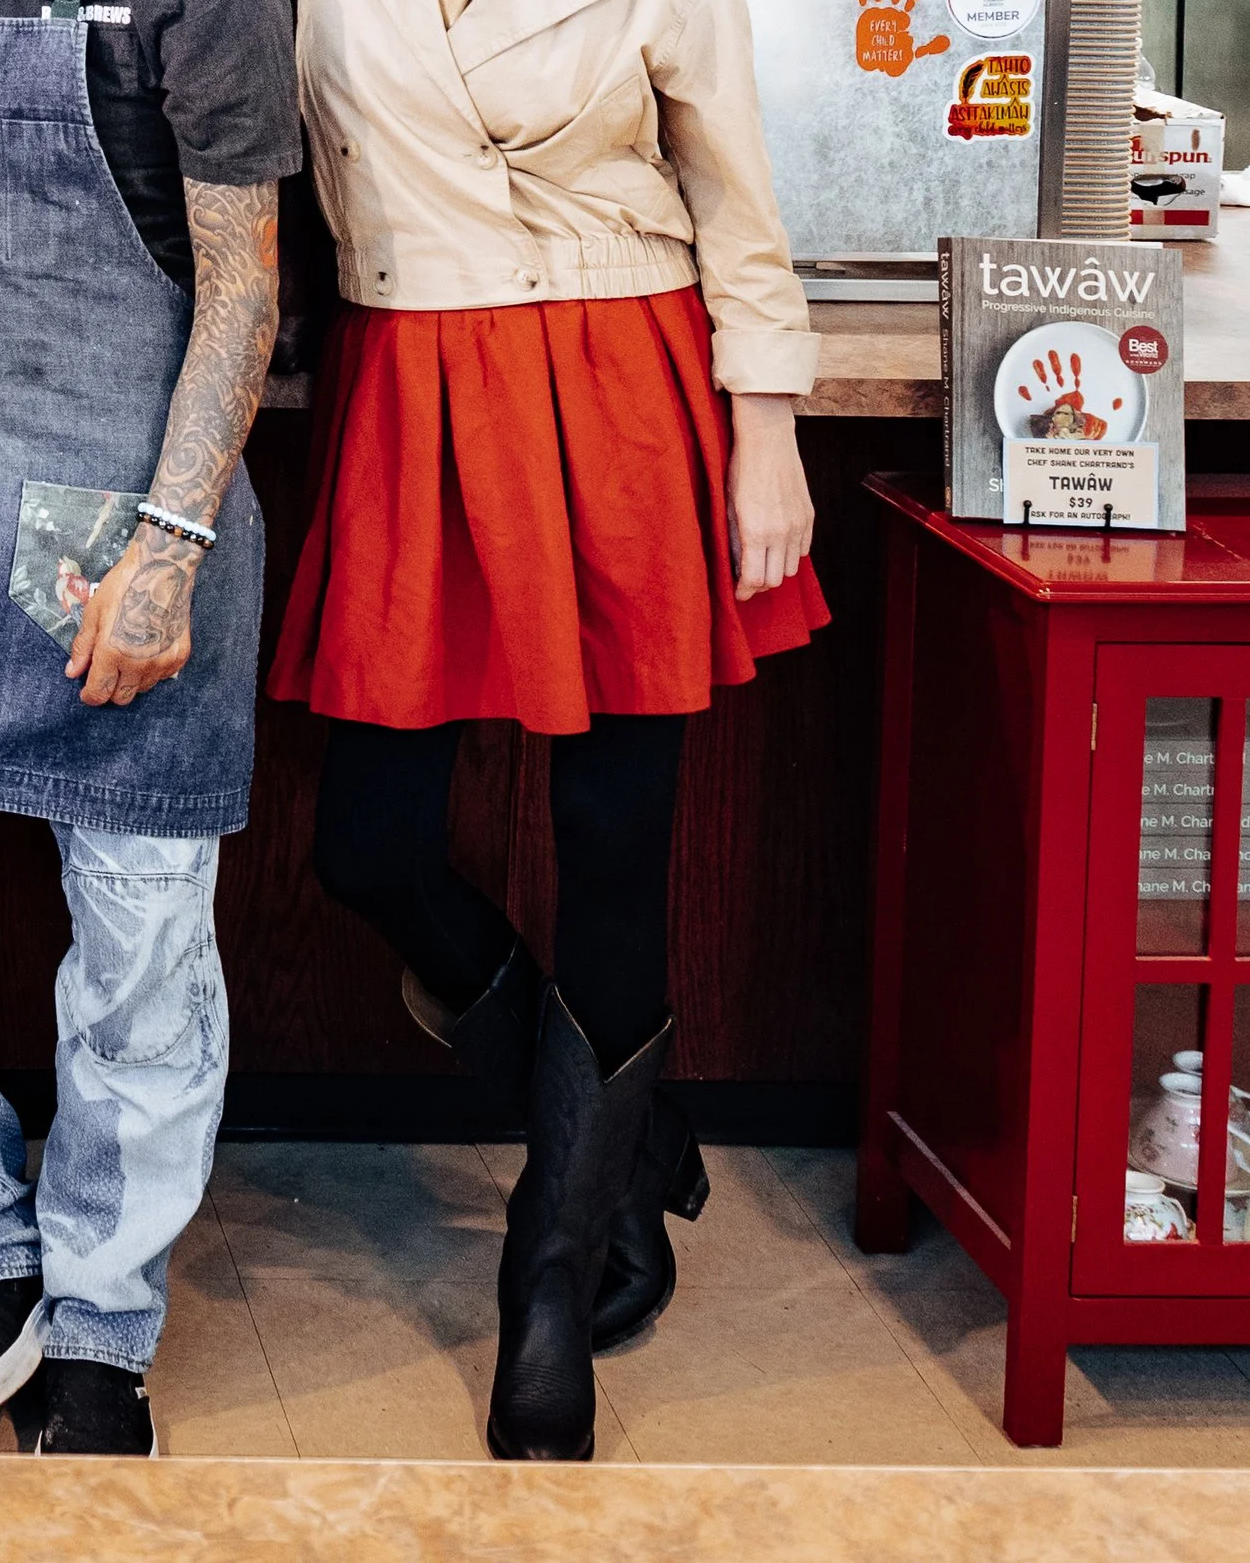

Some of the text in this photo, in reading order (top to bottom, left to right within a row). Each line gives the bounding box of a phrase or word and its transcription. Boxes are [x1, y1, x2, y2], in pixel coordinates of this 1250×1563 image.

[967, 11, 1019, 21] MEMBER
[870, 19, 897, 32] EVERY
[872, 35, 895, 46] CHILD
[979, 253, 1156, 303] tawâw
[982, 300, 1156, 319] Progressive Indigenous Cuisine
[1128, 339, 1158, 353] Best
[1025, 447, 1135, 457] TAKE HOME OUR VERY OWN
[1027, 459, 1135, 469] CHEF SHANE CHARTRAND'S
[1049, 472, 1113, 492] TAWÂW
[1069, 496, 1093, 508] $39
[1050, 511, 1064, 519] FOR
[1157, 752, 1173, 765] M.
[1154, 783, 1170, 796] M.
[1162, 815, 1177, 828] M.
[1164, 848, 1180, 860] M.
[1172, 880, 1188, 893] M.
